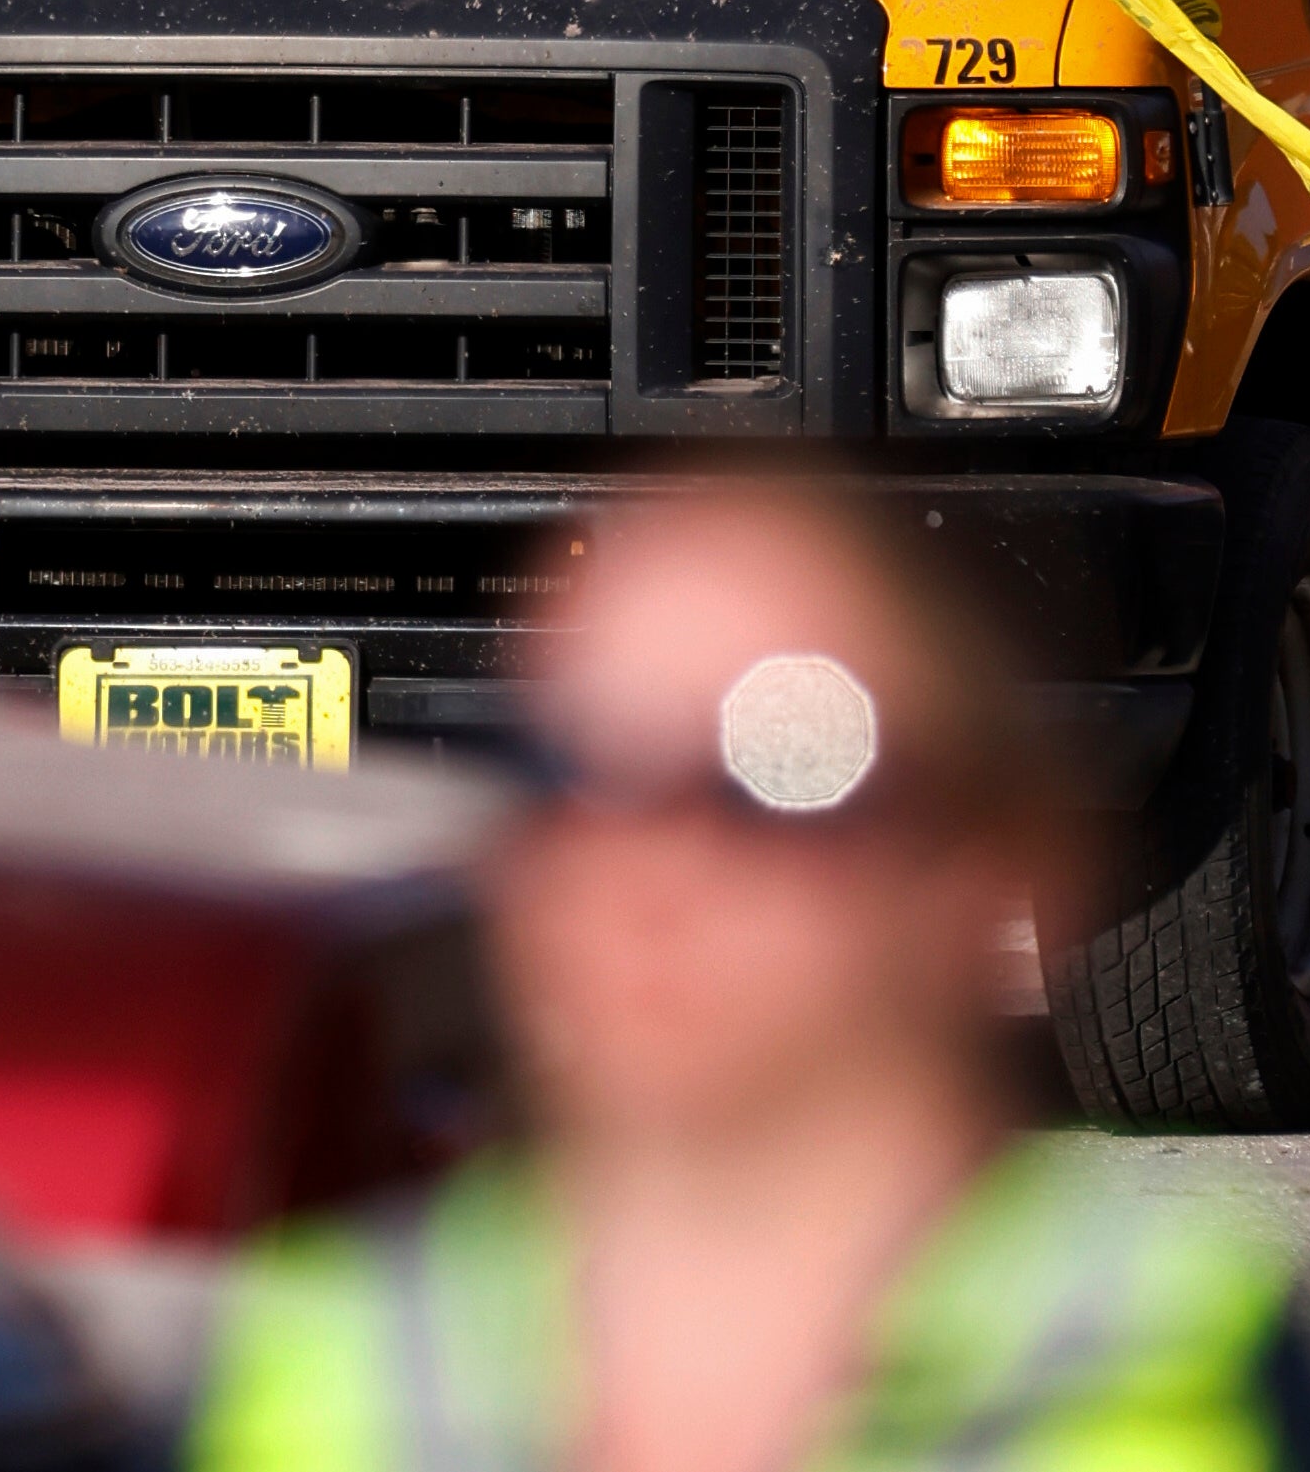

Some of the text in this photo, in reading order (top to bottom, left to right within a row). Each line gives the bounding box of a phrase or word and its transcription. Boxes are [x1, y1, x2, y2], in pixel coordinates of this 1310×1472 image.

[925, 37, 1017, 85] 729
[170, 206, 288, 258] Ford
[107, 684, 301, 729] BOLT
